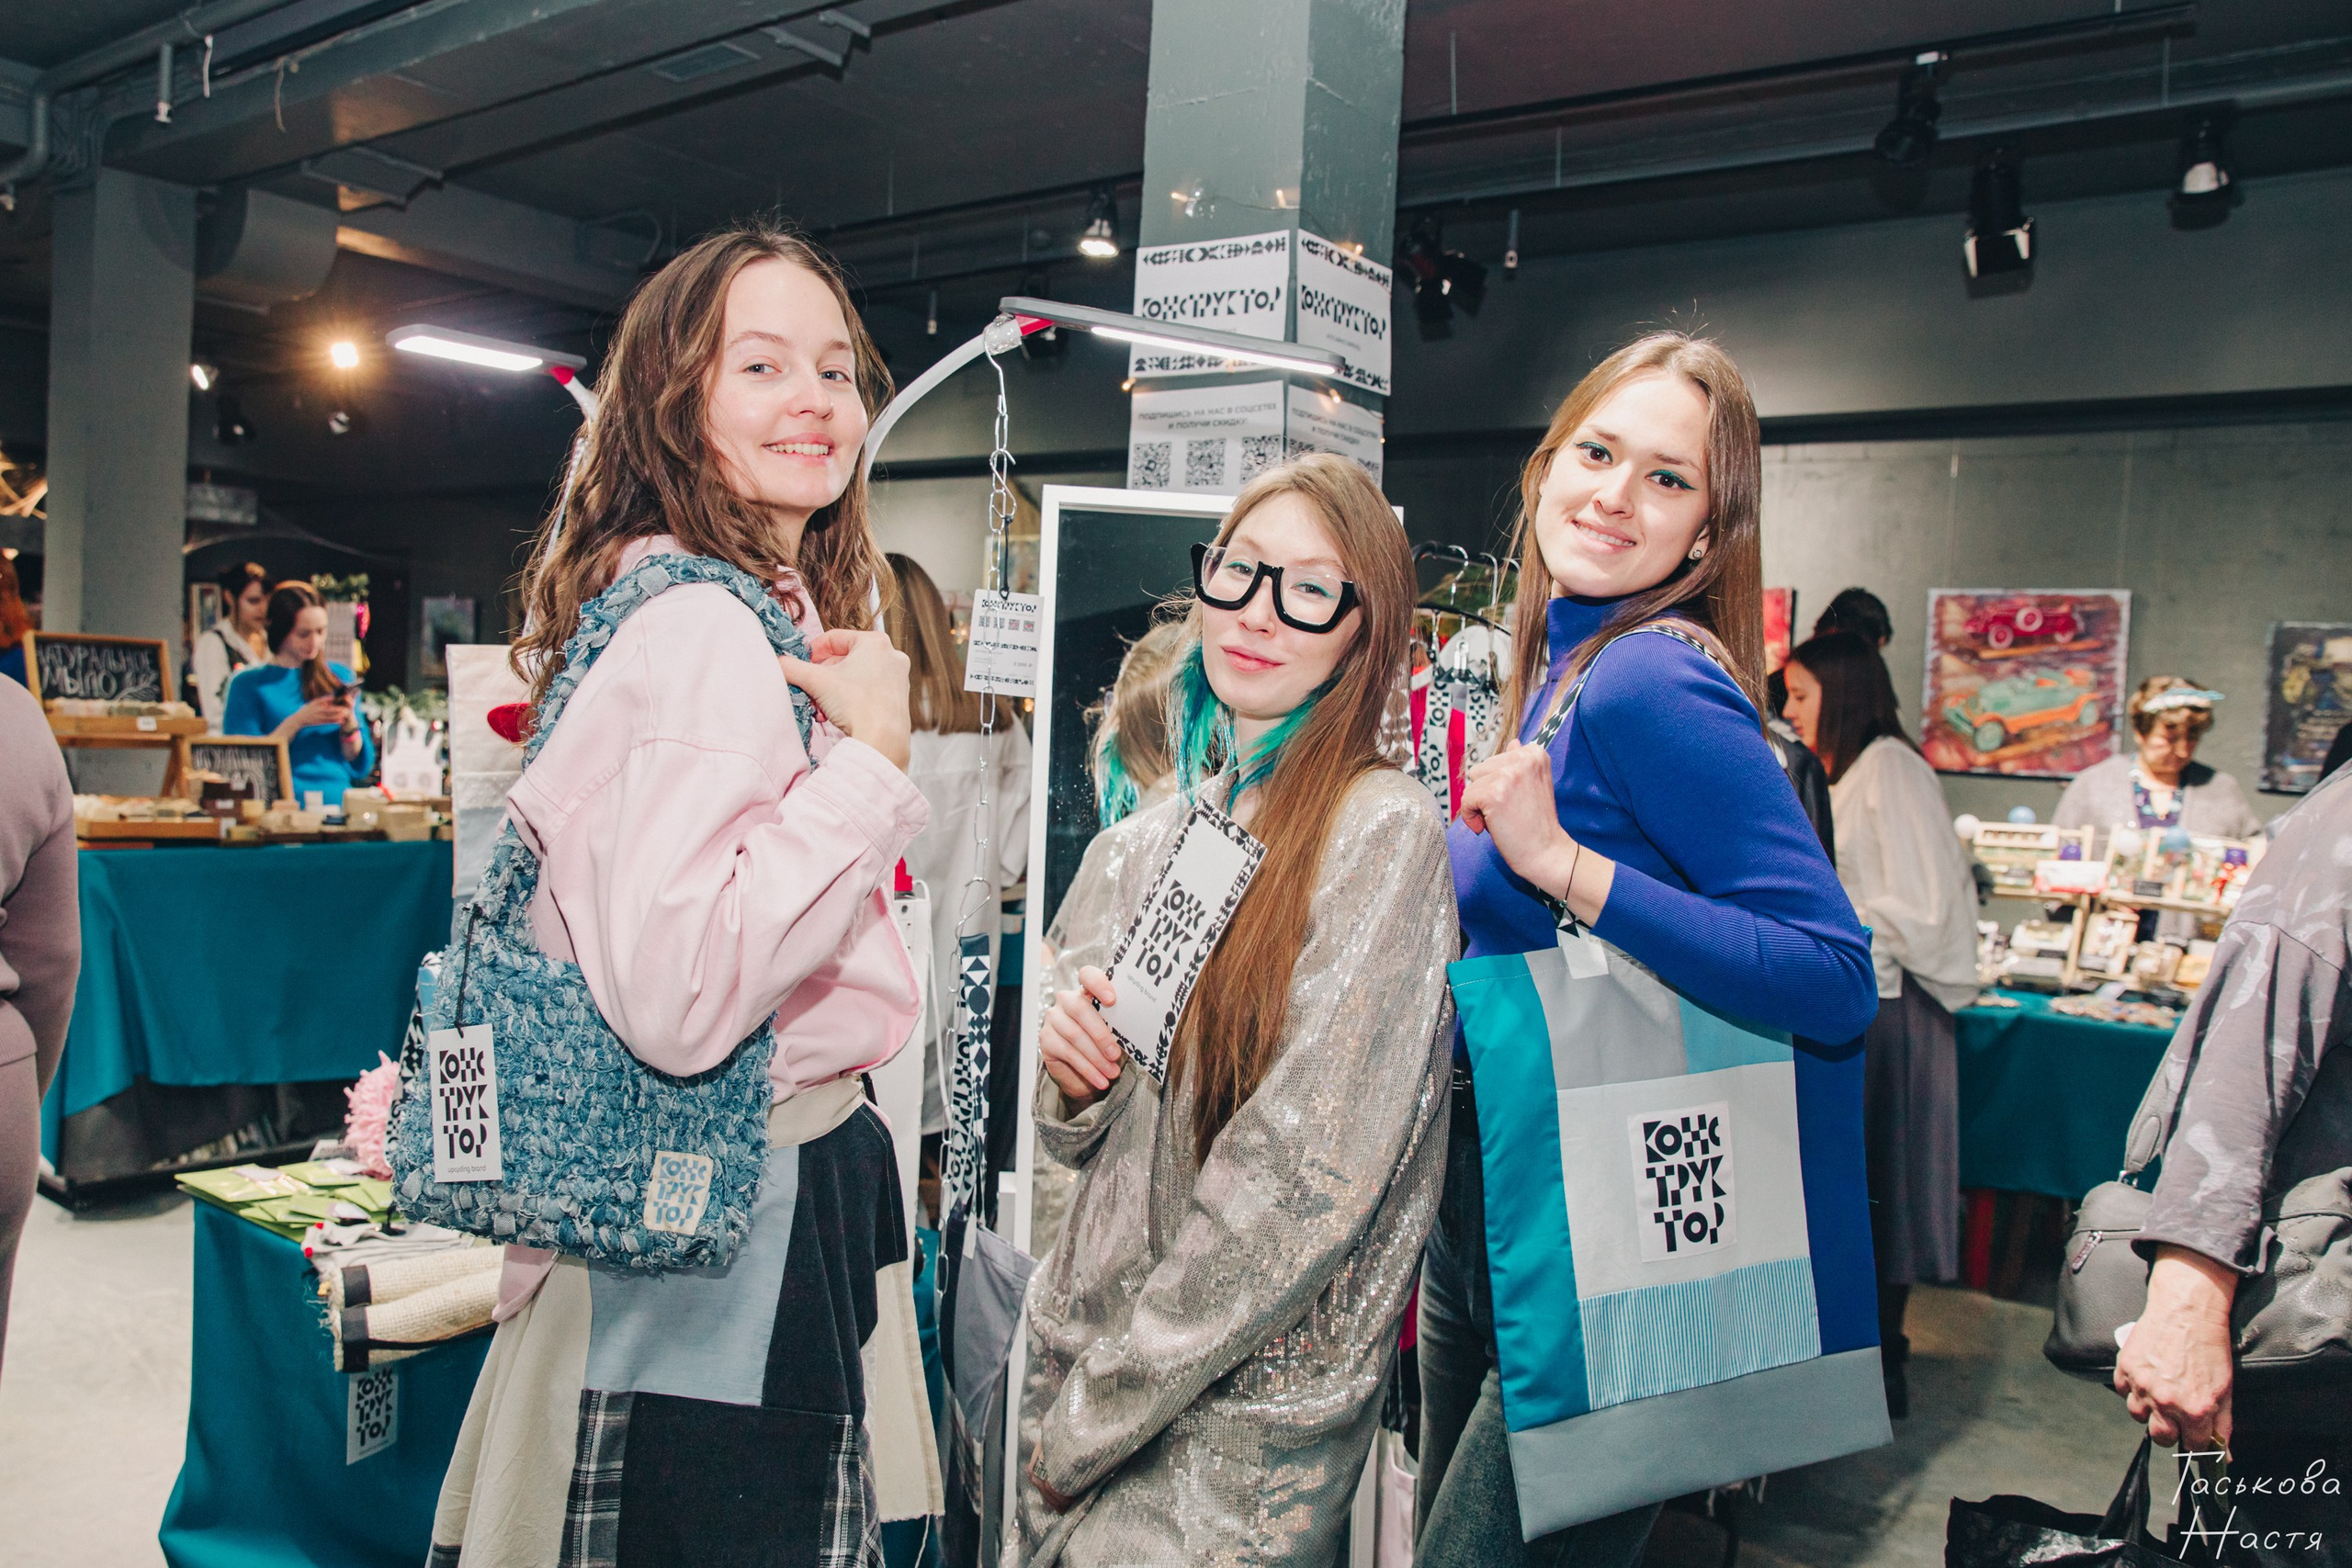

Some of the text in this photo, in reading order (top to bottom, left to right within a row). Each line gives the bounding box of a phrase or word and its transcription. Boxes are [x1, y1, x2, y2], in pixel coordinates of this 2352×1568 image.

[1142, 286, 1281, 320] КОНСТРУКТОР
[1301, 284, 1386, 340] КОНСТРУКТОР
[1162, 879, 1206, 931] КОНС
[1148, 908, 1193, 964] ТРУК
[1135, 937, 1172, 987] ТОР
[439, 1047, 485, 1084] КОНС
[439, 1084, 490, 1122] ТРУК
[443, 1122, 487, 1159] ТОР
[1643, 1113, 1721, 1164] КОНС
[660, 1156, 707, 1181] КОНС
[1645, 1155, 1727, 1208] ТРУК
[657, 1180, 705, 1205] ТРУК
[653, 1201, 694, 1226] ТОР
[1653, 1201, 1724, 1252] ТОР
[356, 1415, 390, 1447] ТОР
